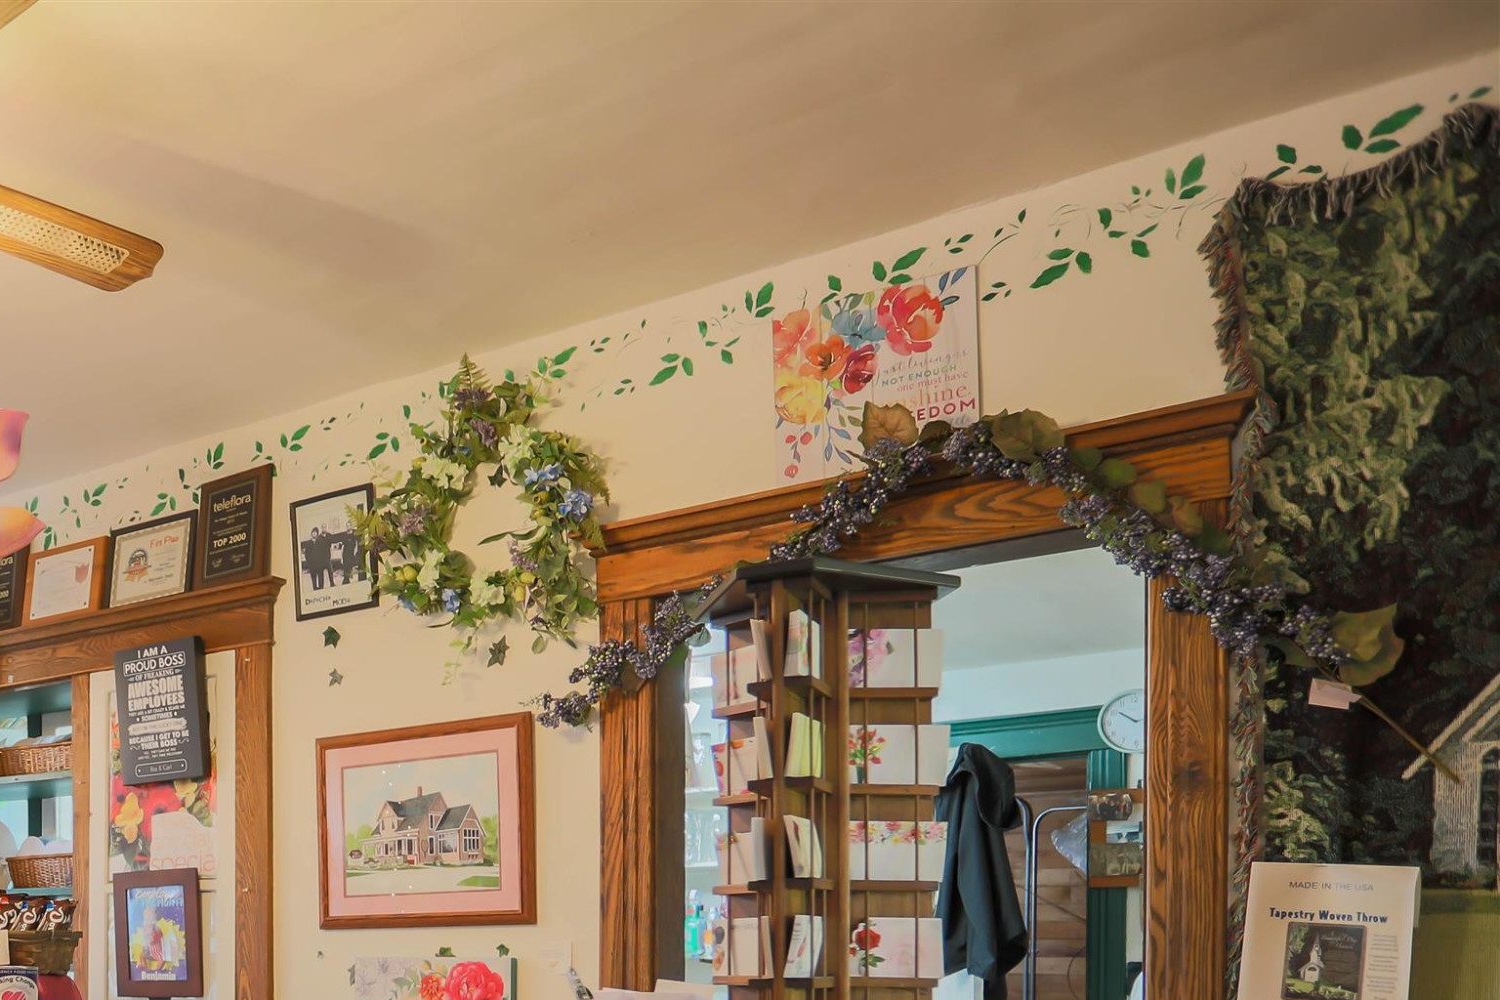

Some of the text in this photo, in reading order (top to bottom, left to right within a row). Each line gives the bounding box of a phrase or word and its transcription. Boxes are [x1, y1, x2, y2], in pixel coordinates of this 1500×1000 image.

[881, 365, 957, 387] NOT ENOUGH
[897, 371, 969, 392] one must have
[917, 398, 976, 421] EDOM
[213, 494, 251, 512] teleflora
[213, 532, 246, 548] TOP 2000
[138, 645, 167, 658] I AM A
[125, 654, 183, 674] PROUD BOSS
[144, 669, 174, 679] FREAKING
[128, 674, 183, 699] AWESOME
[128, 692, 185, 711] EMPLOYEES
[142, 712, 173, 721] SOMETIMES
[129, 734, 154, 745] BECAUSE
[141, 742, 159, 750] THEIR
[1289, 881, 1318, 889] MADE
[1321, 882, 1331, 890] IN
[1354, 883, 1374, 891] USA
[1269, 908, 1387, 923] Tapestry Woven Throw
[15, 977, 35, 989] Change
[141, 971, 176, 981] Benjamin
